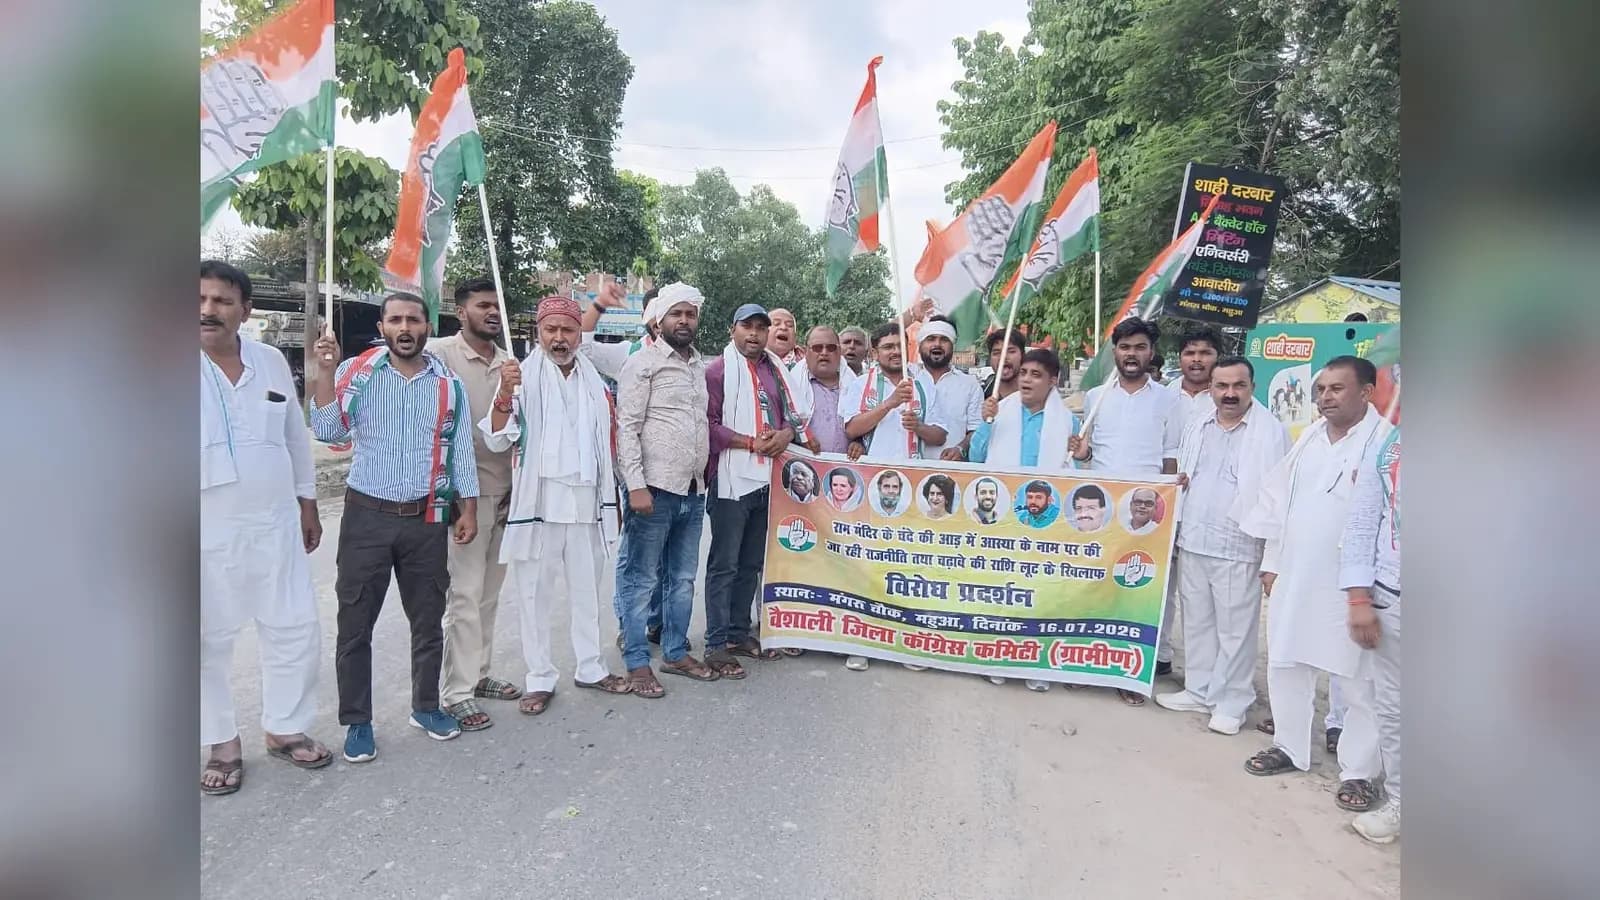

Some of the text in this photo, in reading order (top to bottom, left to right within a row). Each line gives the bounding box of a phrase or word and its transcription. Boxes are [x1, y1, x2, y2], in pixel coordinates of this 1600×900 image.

[1194, 177, 1276, 202] शाही दरबार
[1191, 277, 1242, 293] आवासीय
[1266, 337, 1312, 357] शाही दरबार
[832, 521, 850, 535] राम
[854, 523, 878, 540] मंदिर
[881, 526, 893, 540] के
[897, 526, 915, 543] चंदे
[918, 529, 934, 544] की
[939, 533, 961, 549] आड़
[965, 532, 977, 547] में
[1020, 537, 1032, 551] के
[1036, 541, 1060, 554] नाम
[1064, 543, 1080, 556] पर
[1083, 543, 1102, 557] की
[826, 540, 841, 554] जा
[844, 544, 862, 558] रही
[865, 548, 908, 563] राजनीति
[970, 556, 987, 570] की
[990, 558, 1016, 573] राशि
[1019, 561, 1041, 578] लूट
[1043, 562, 1056, 575] के
[1060, 562, 1106, 580] खिलाफ
[885, 572, 1035, 608] विरोध प्रदर्शन
[768, 606, 836, 633] वैशाली
[841, 614, 897, 644] जिला
[973, 639, 1042, 661] कमिटी
[1049, 640, 1143, 676] (ग्रामीण)
[1038, 622, 1141, 639] 16.07.2026
